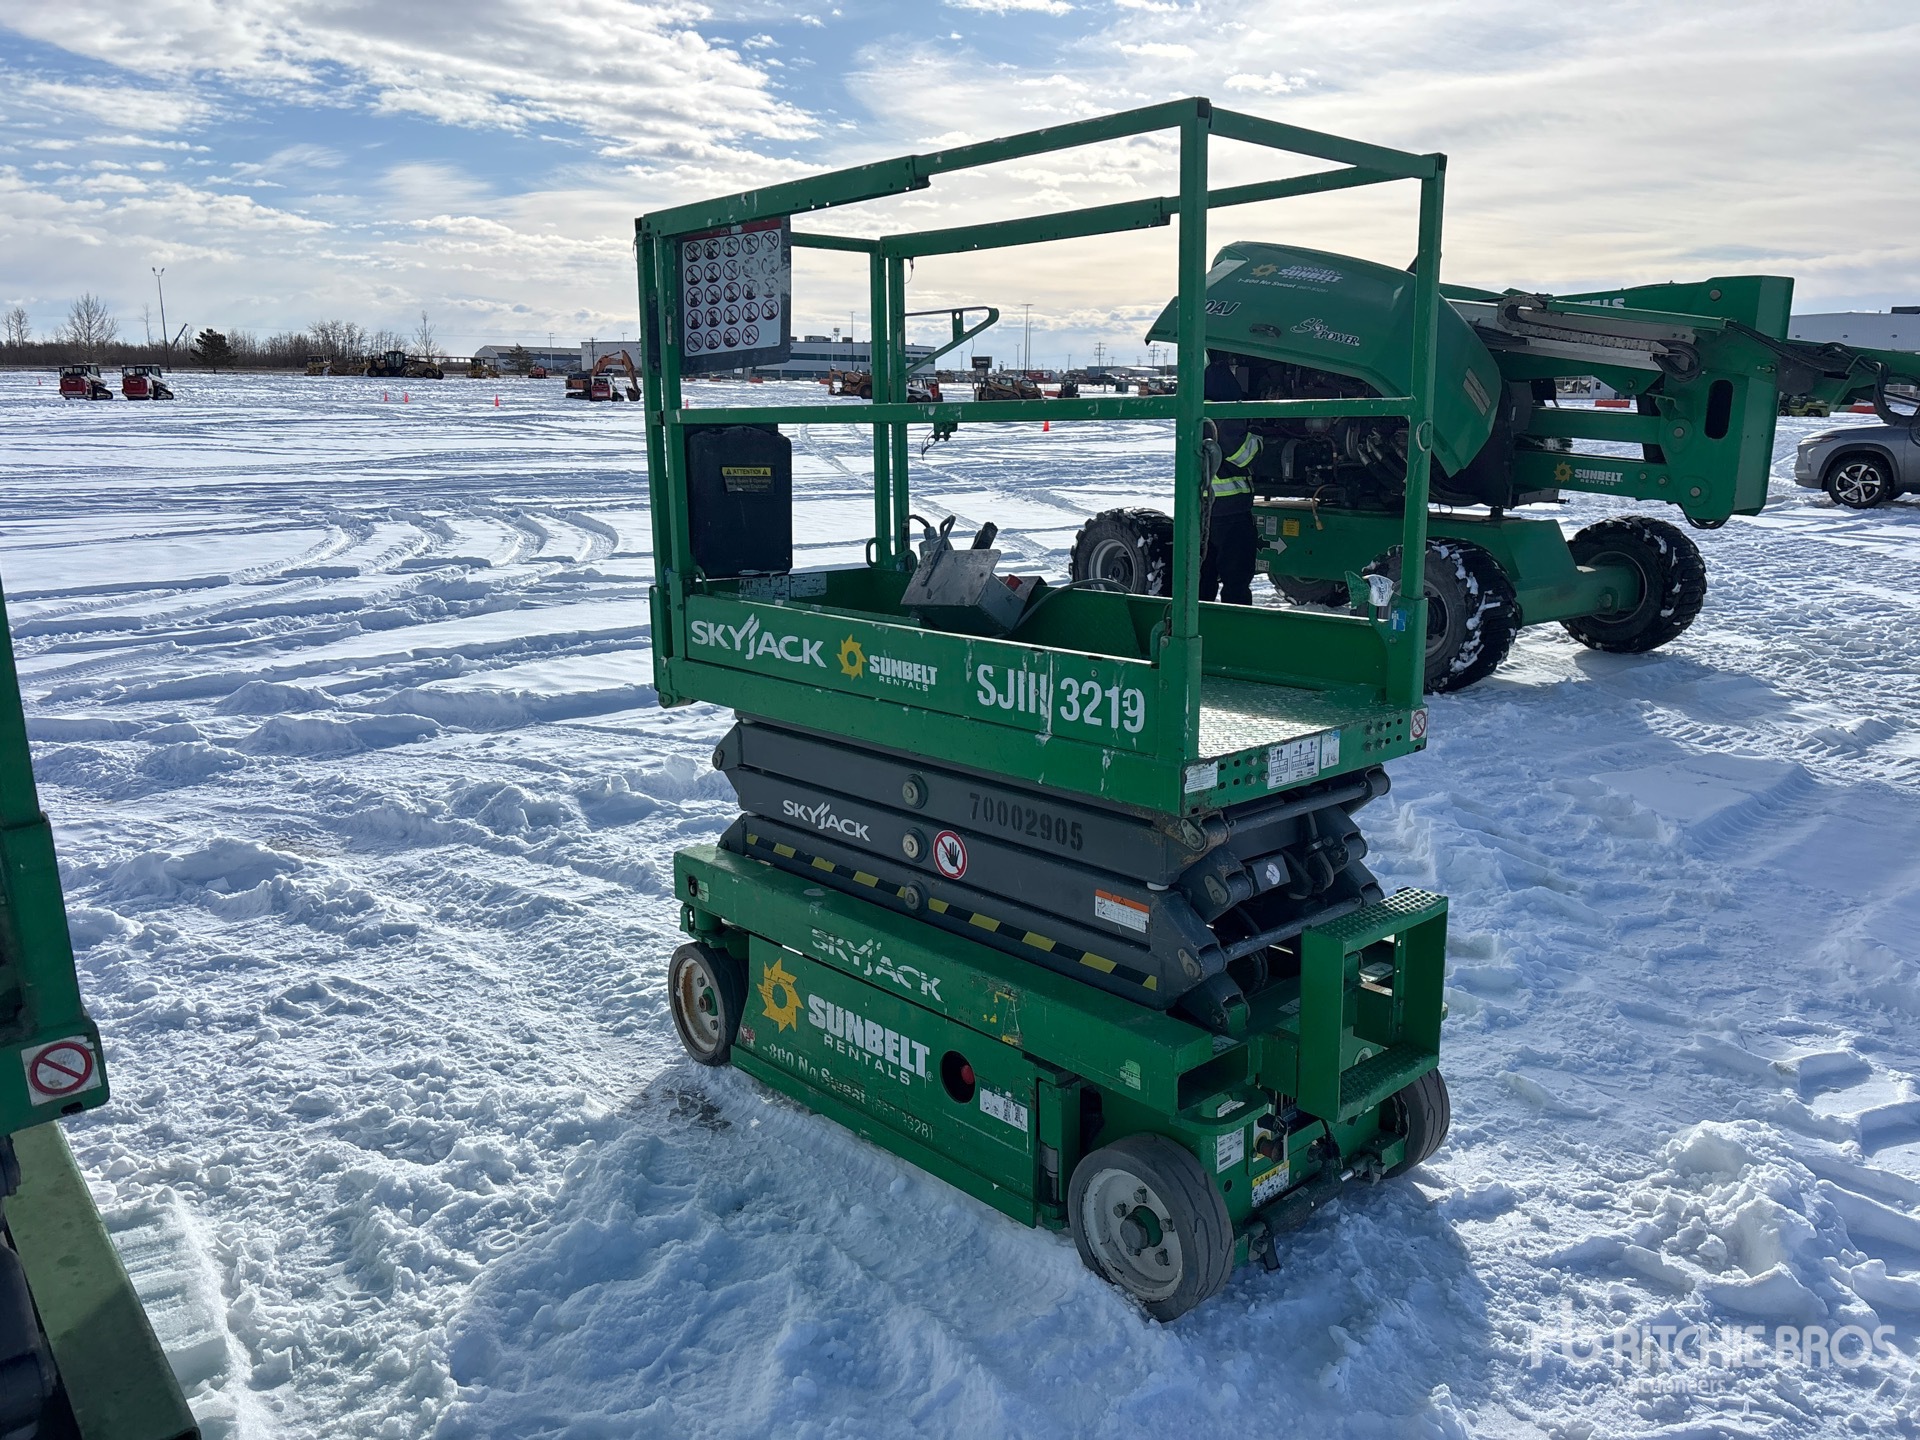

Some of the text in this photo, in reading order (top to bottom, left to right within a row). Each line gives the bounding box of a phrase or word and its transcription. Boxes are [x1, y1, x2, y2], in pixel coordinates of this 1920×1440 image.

[1574, 469, 1623, 483] SUNBELT
[691, 612, 827, 668] SKYJACK
[869, 655, 938, 686] SUNBELT
[878, 675, 929, 692] RENTALS
[1060, 677, 1146, 733] 3219
[782, 800, 871, 842] SKYJACK
[969, 792, 1084, 851] 70002905
[811, 928, 945, 1004] SKYJACK
[807, 993, 931, 1079] SUNBELT
[823, 1033, 911, 1086] RENTALS
